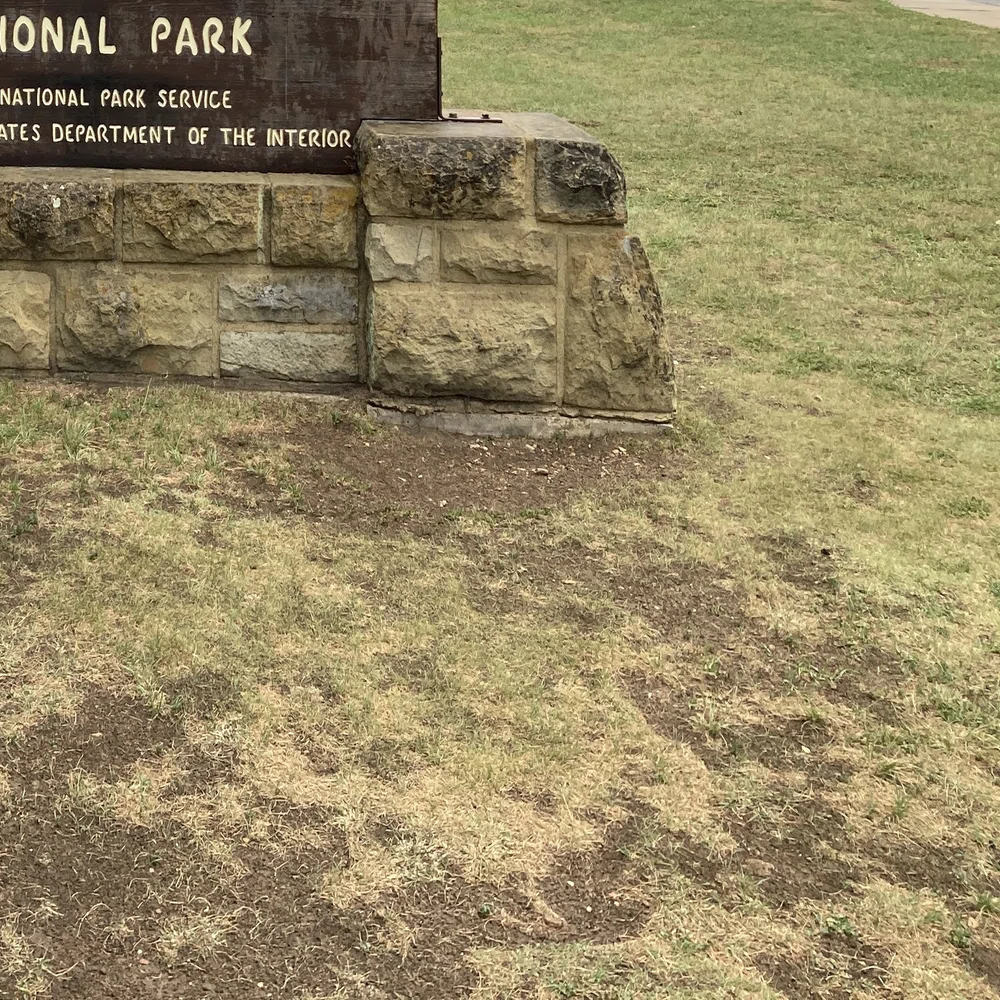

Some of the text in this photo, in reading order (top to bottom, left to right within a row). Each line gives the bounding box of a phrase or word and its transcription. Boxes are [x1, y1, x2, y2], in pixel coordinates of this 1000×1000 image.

[150, 16, 253, 56] PARK
[0, 87, 233, 109] NATIONAL PARK SERVICE
[52, 122, 176, 145] DEPARTMENT
[187, 126, 210, 146] OF
[219, 127, 256, 147] THE
[266, 127, 352, 148] INTERIOR
